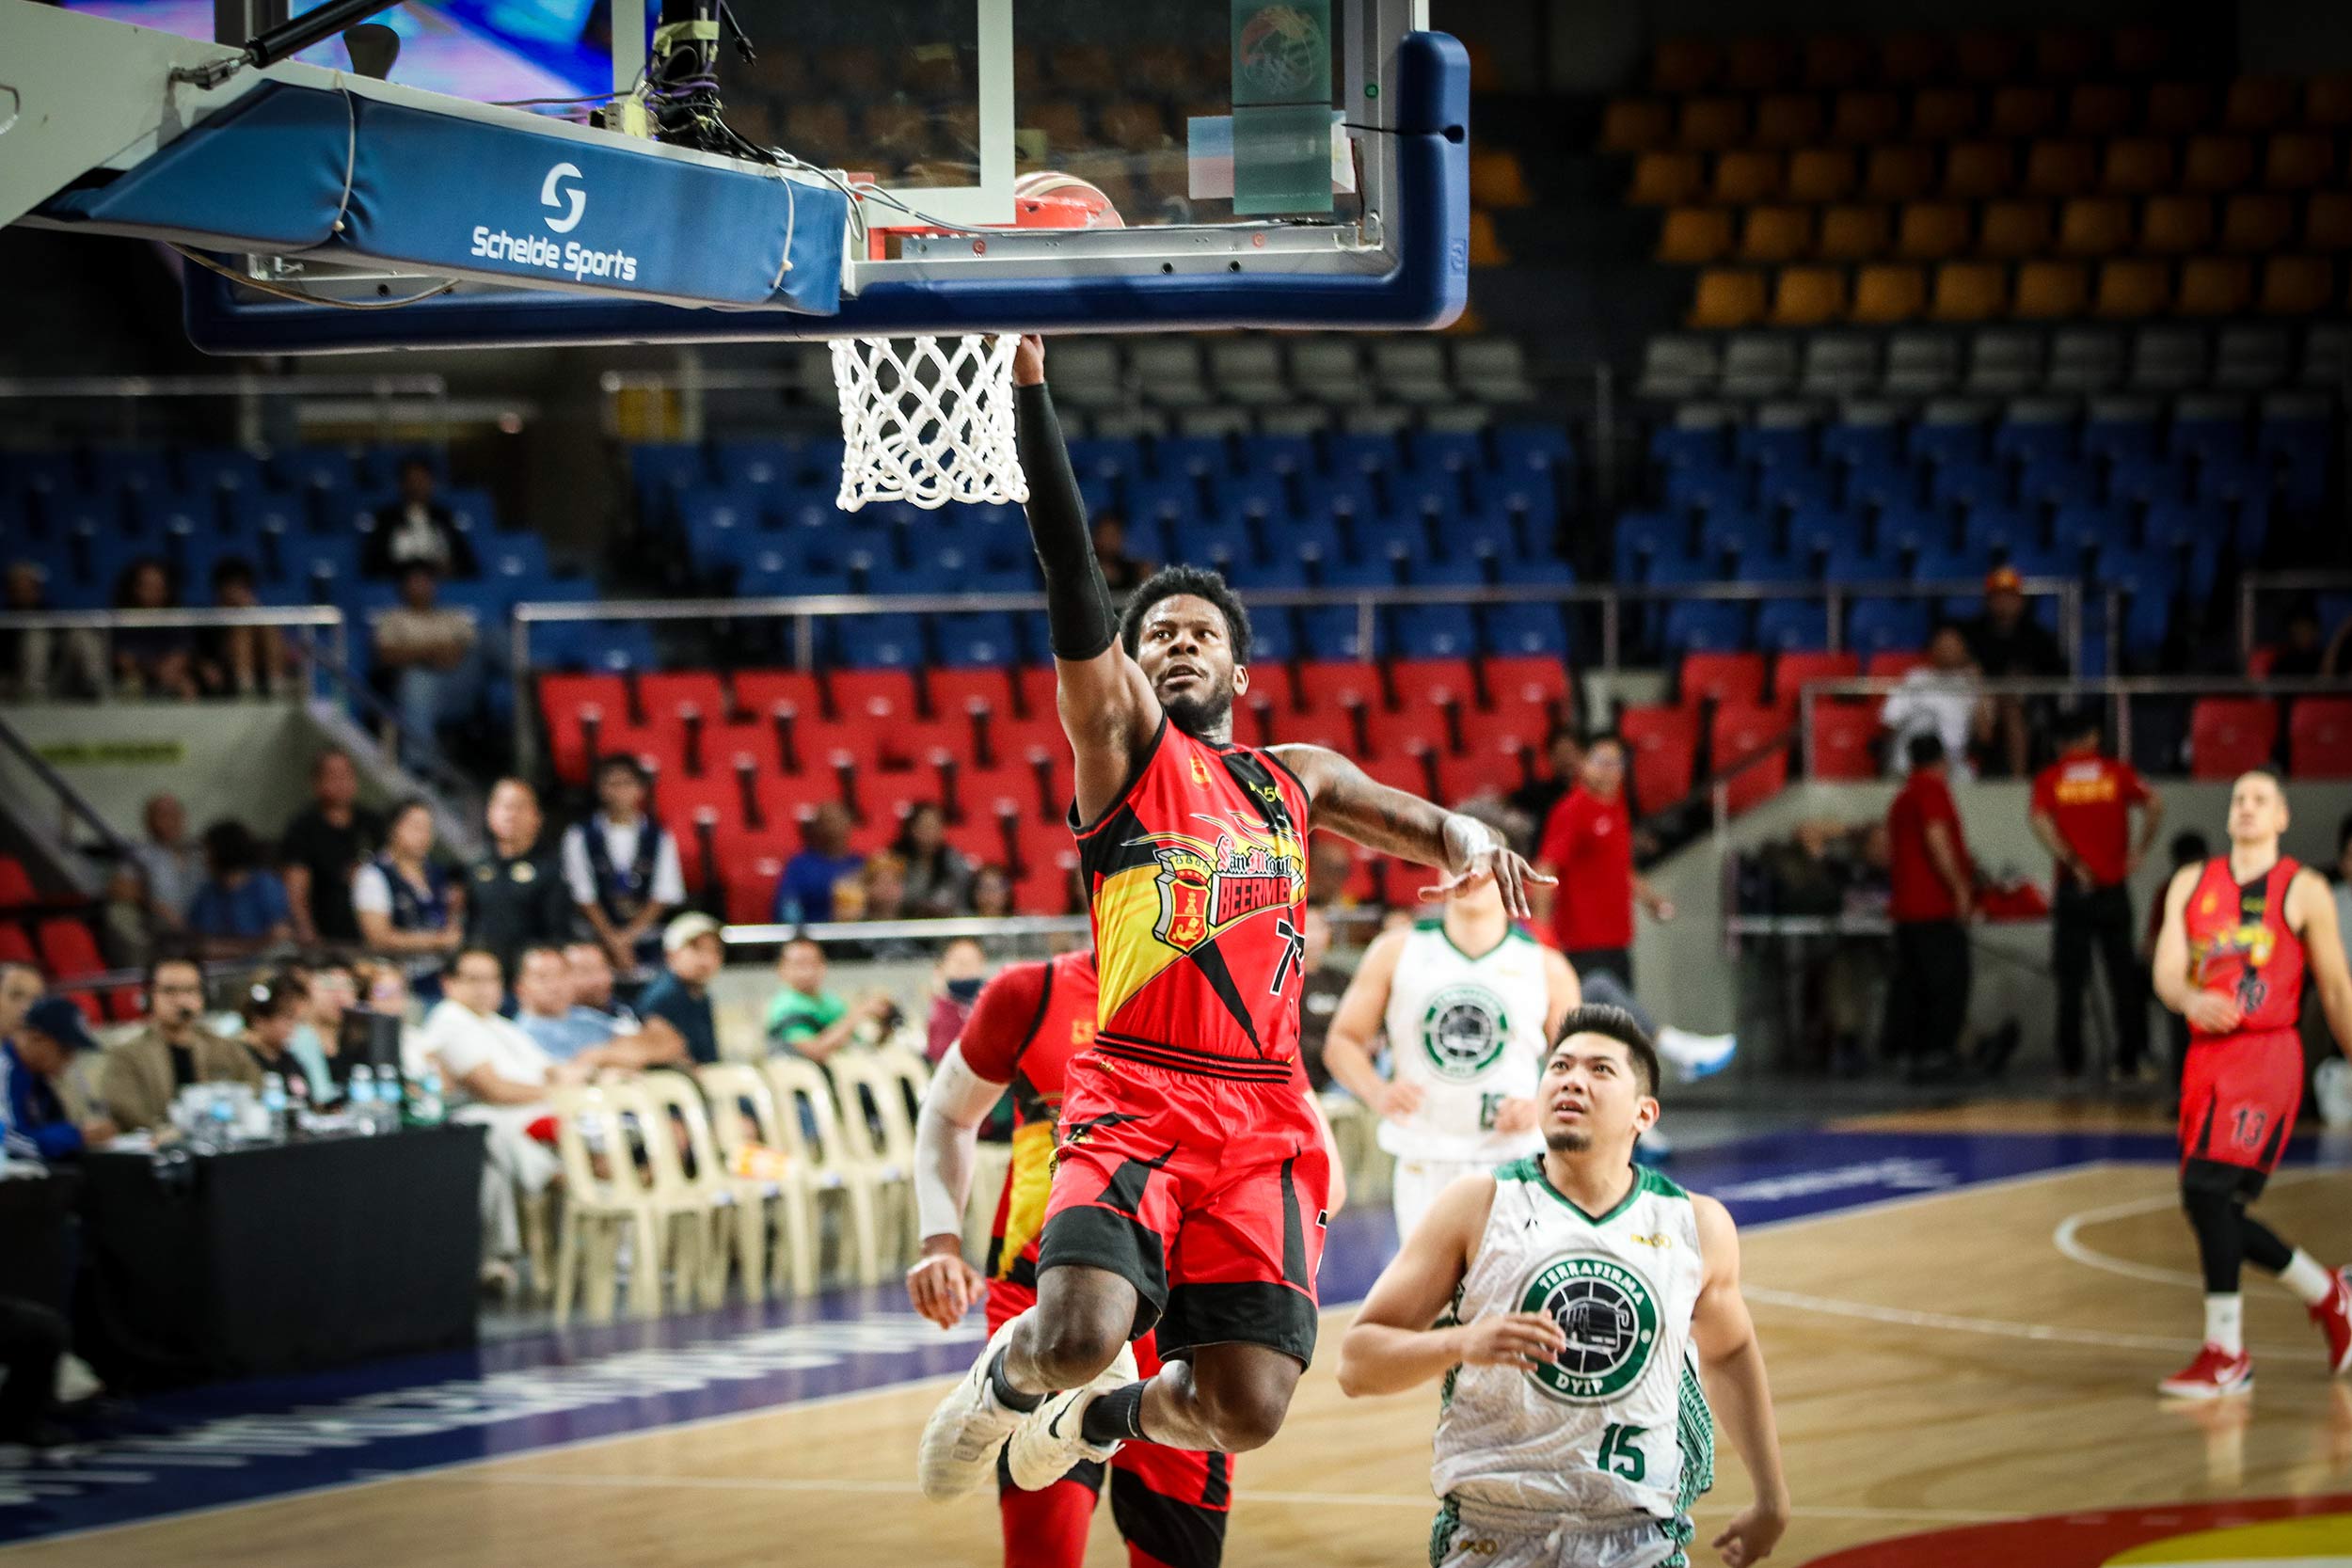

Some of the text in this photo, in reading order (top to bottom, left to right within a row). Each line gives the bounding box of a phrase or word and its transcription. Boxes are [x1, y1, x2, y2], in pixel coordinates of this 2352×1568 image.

[470, 226, 638, 282] Schelde Sports
[1216, 834, 1247, 873] San
[1537, 1260, 1645, 1307] TERRAFIRMA
[1554, 1373, 1604, 1396] DYIP
[1597, 1421, 1650, 1482] 15
